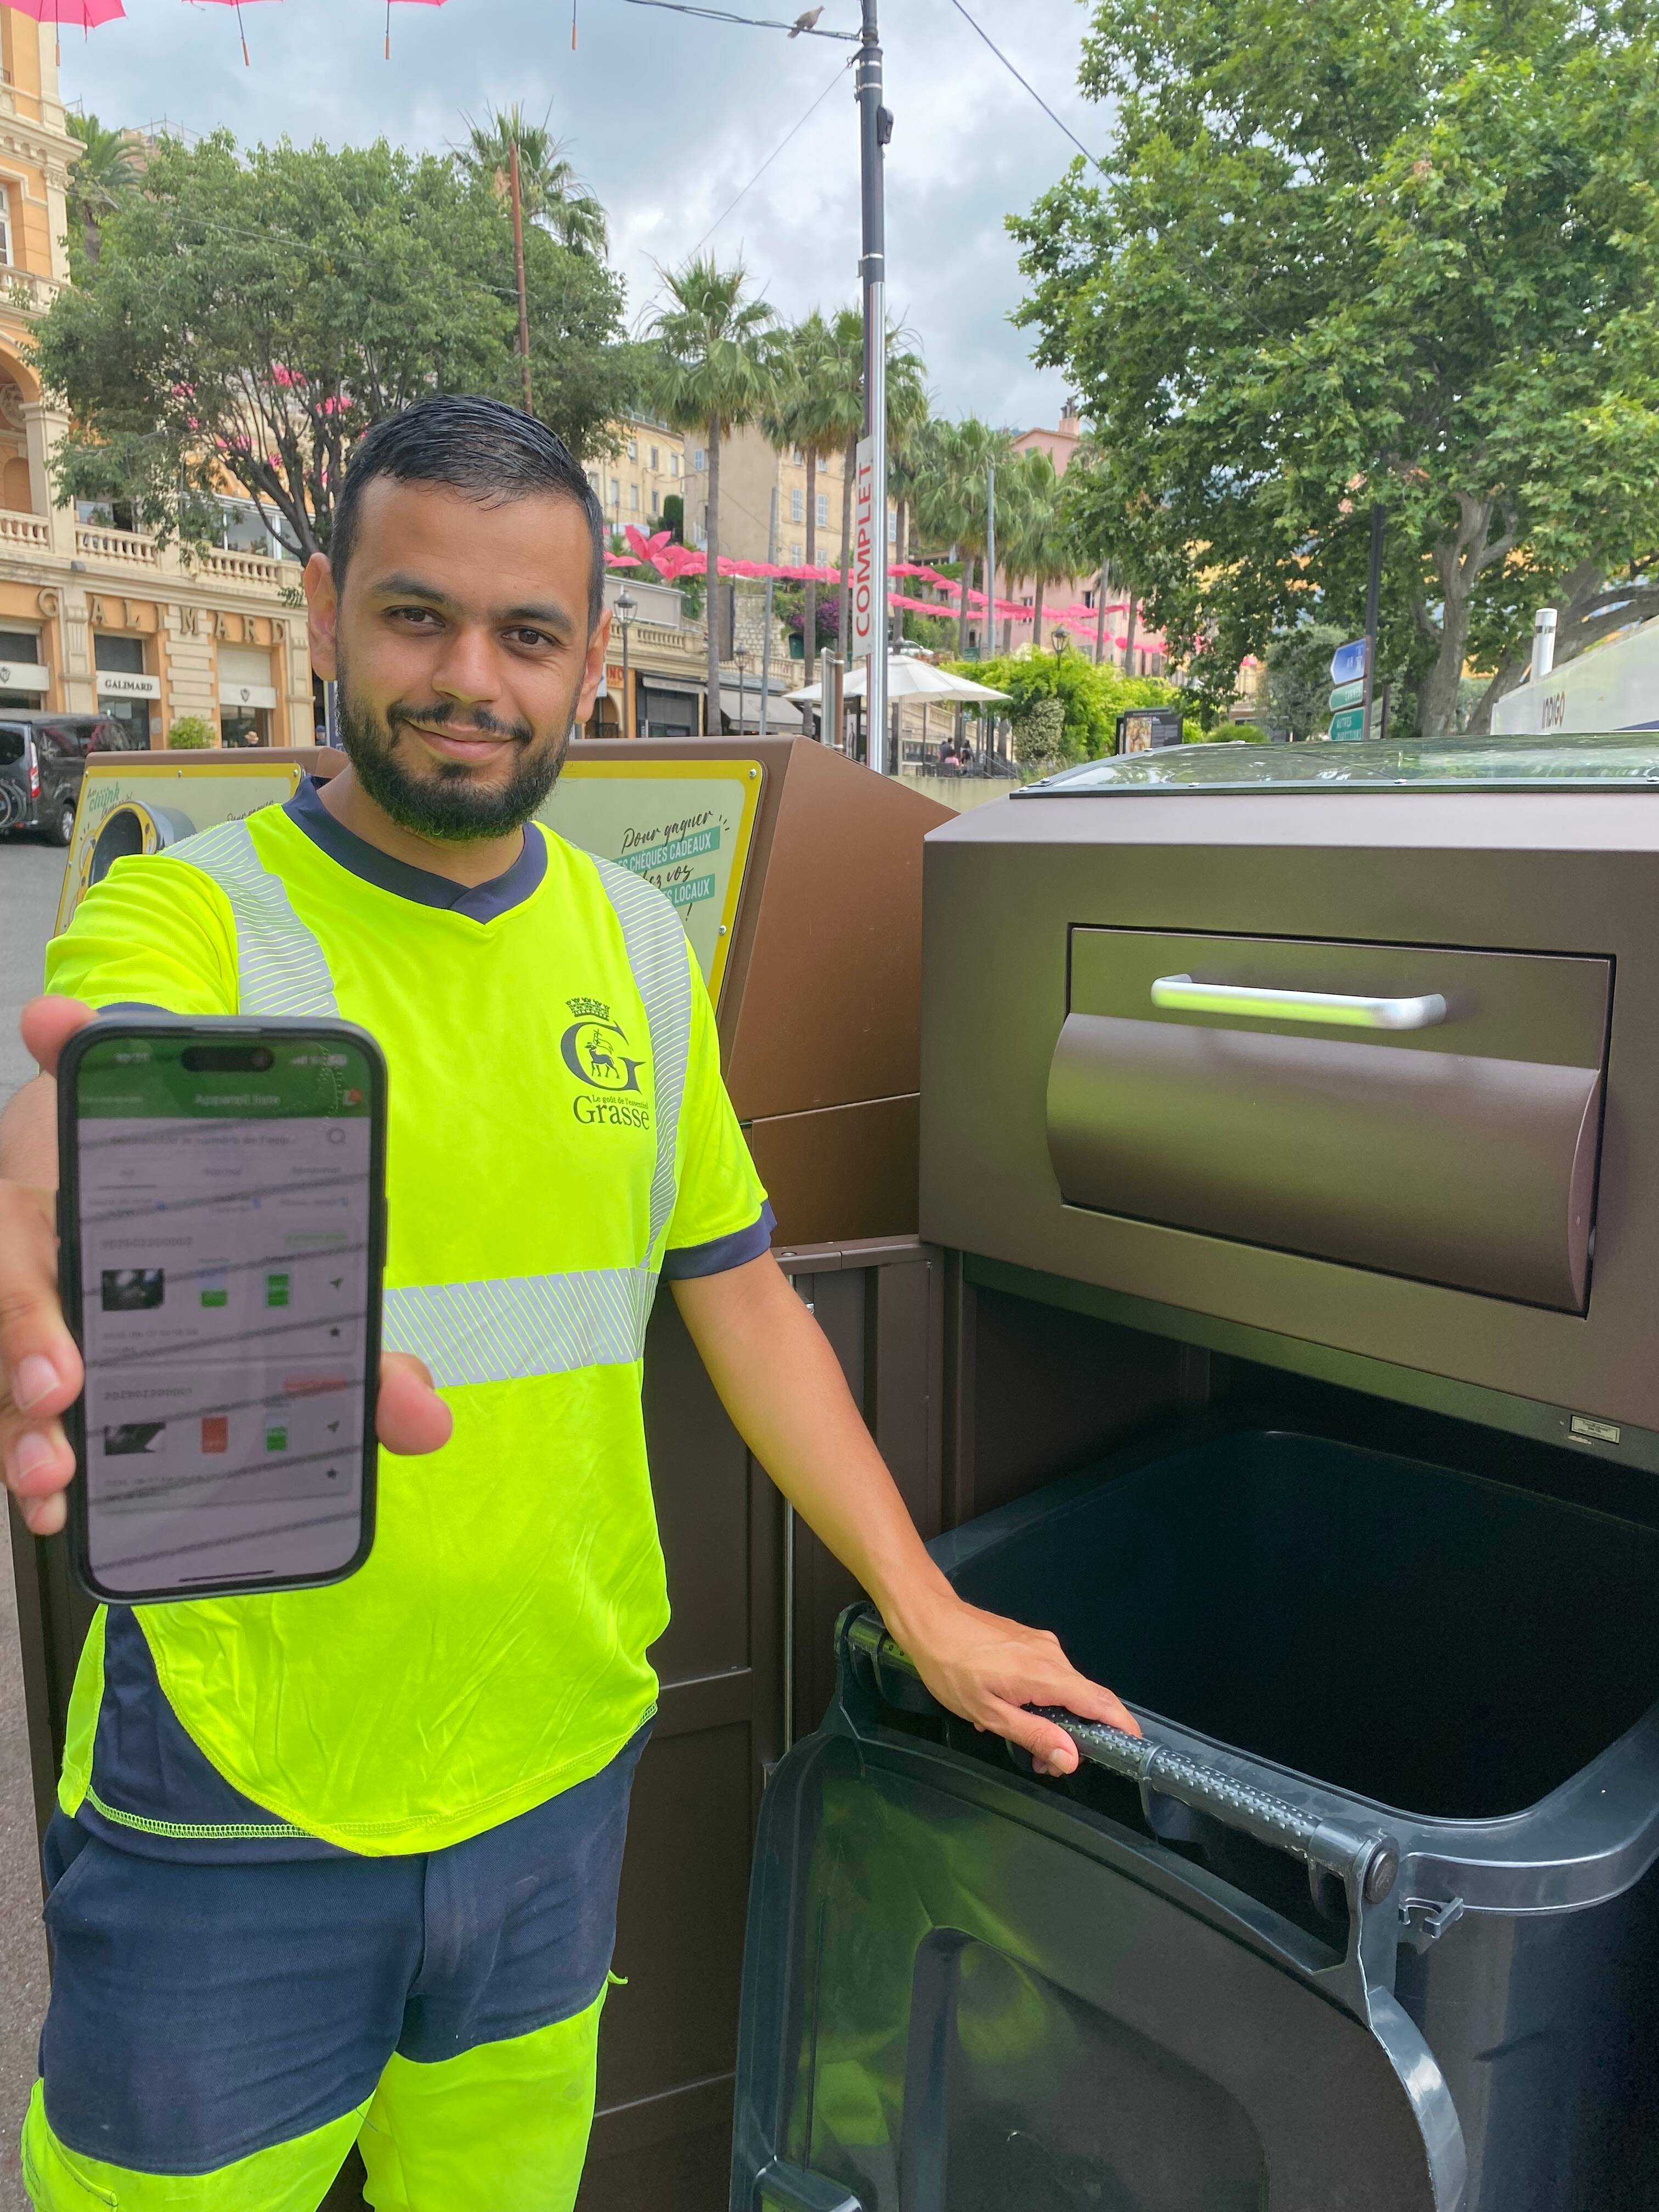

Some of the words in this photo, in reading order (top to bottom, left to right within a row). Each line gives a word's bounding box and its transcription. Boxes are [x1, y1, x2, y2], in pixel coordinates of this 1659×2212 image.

[856, 462, 871, 637] COMPLET
[38, 587, 286, 644] GALIMARD
[105, 679, 153, 692] GALIMARD
[1542, 690, 1565, 729] INDIGO
[621, 827, 661, 854] Pour
[662, 810, 714, 848] gagner
[629, 847, 668, 871] CHÈQUES
[669, 832, 712, 860] CADEAUX
[667, 865, 694, 883] vos
[674, 878, 710, 904] LOCAUX
[573, 1095, 650, 1130] Grasse
[602, 1096, 617, 1104] goût
